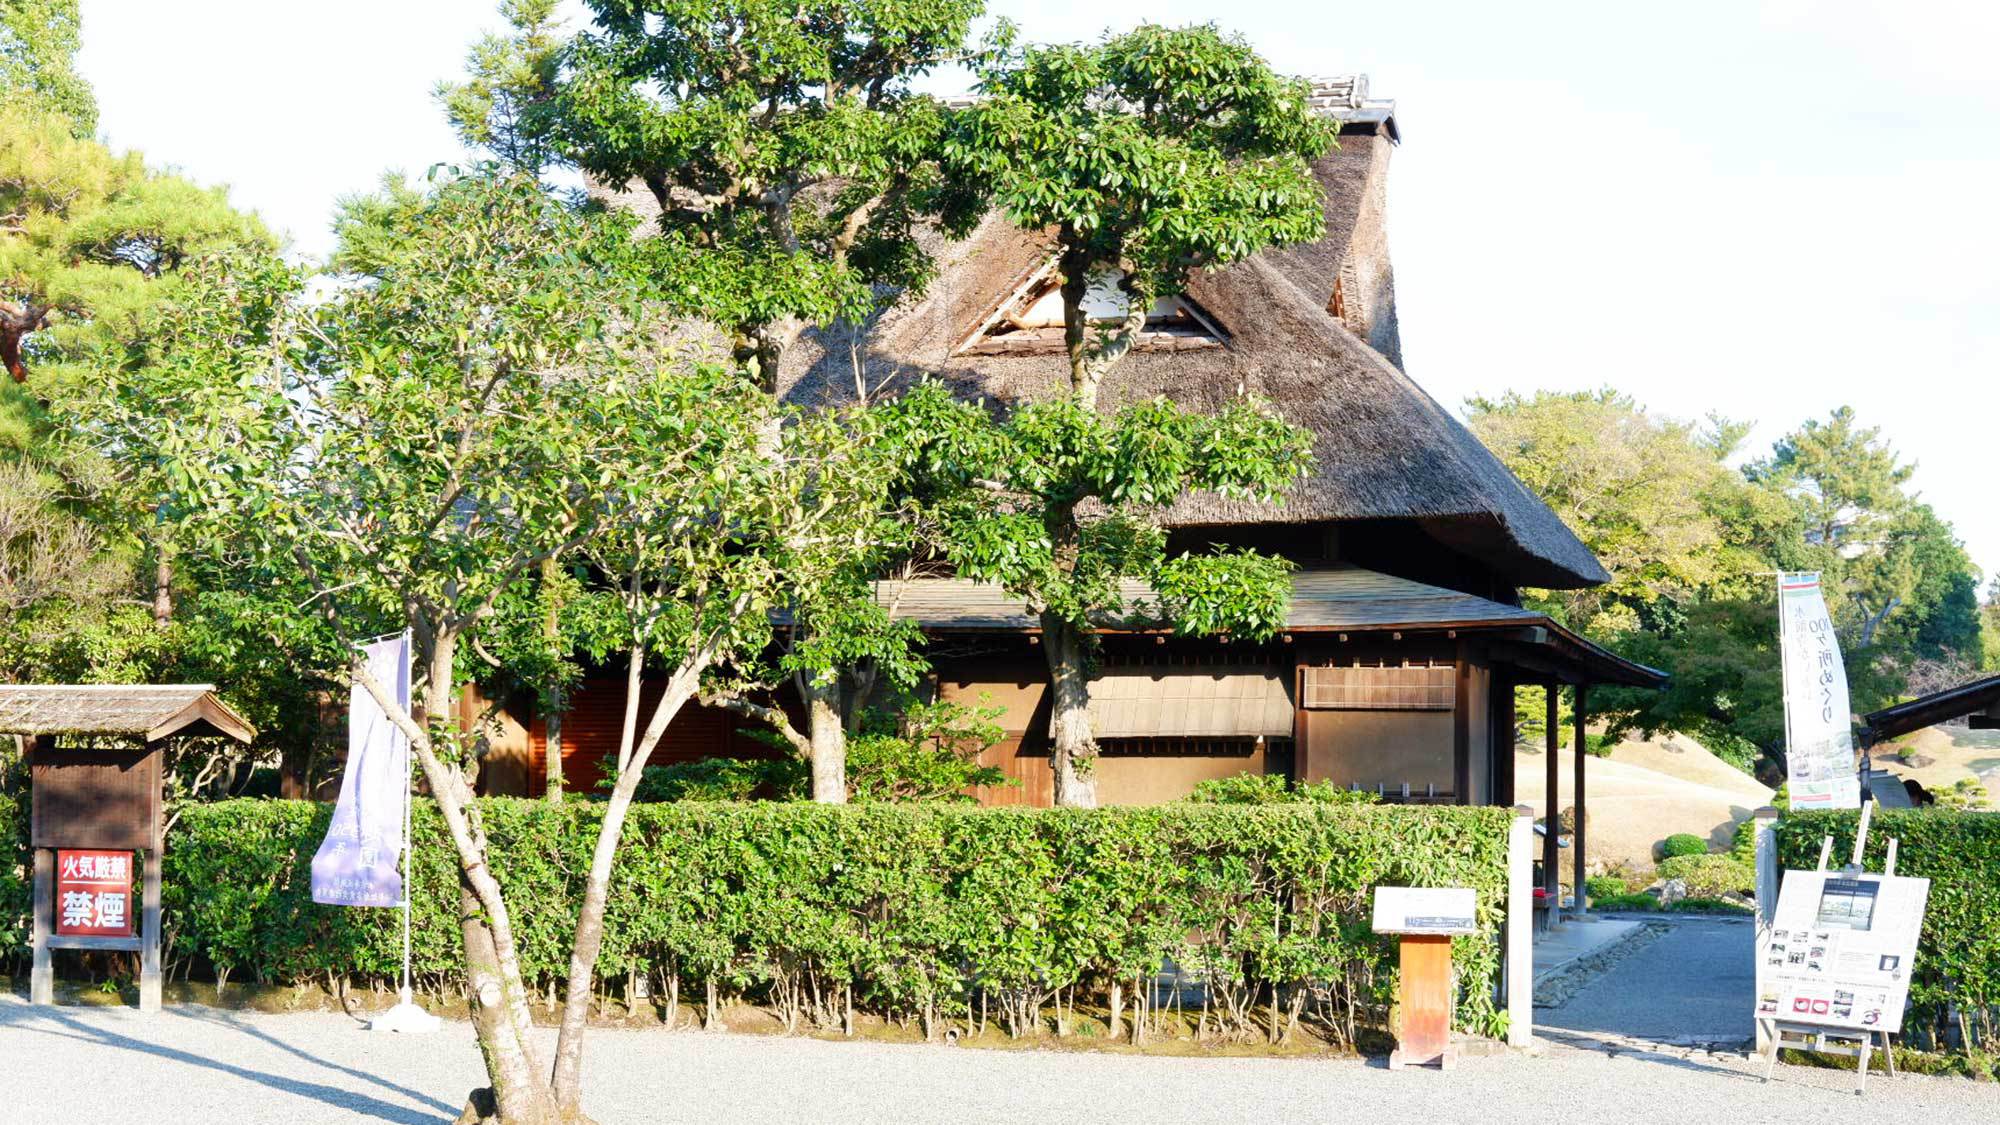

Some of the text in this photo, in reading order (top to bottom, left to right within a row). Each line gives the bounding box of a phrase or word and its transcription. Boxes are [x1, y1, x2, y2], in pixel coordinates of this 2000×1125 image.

[62, 855, 126, 879] 火気厳禁
[62, 890, 126, 928] 禁煙
